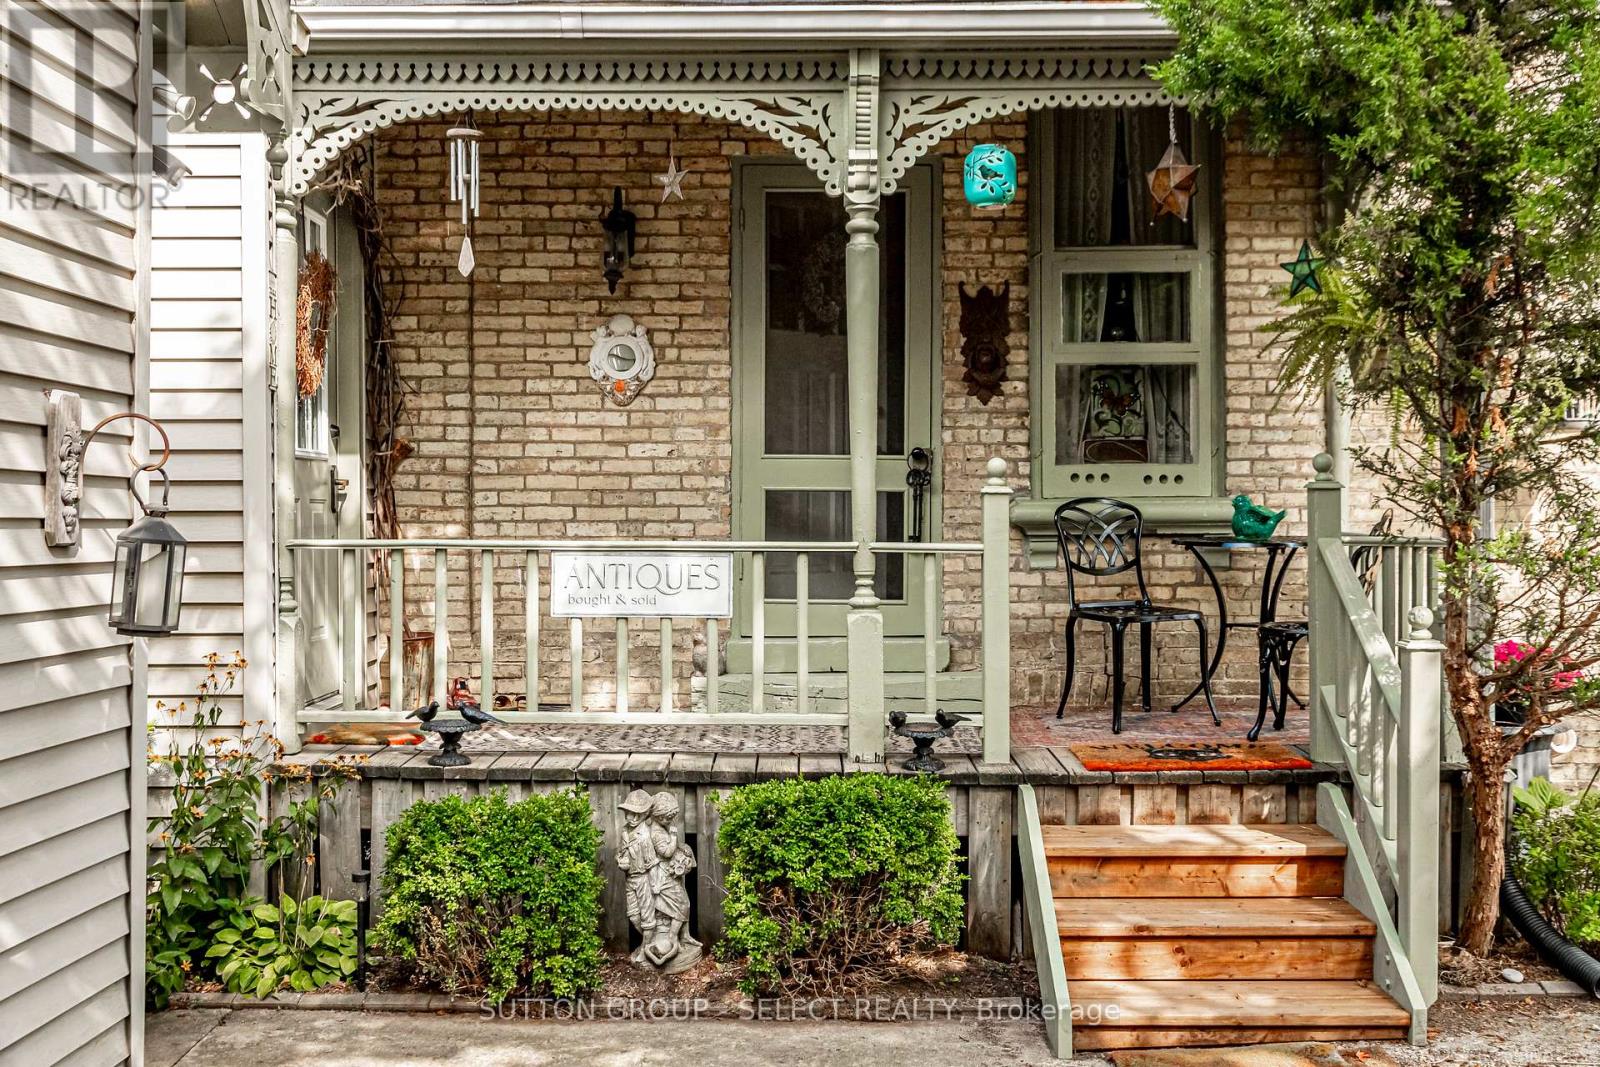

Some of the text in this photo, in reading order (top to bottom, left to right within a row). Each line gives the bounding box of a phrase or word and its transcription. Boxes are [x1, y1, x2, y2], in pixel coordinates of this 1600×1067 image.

[564, 562, 721, 596] ANTIQUES
[567, 593, 657, 607] bought & sold
